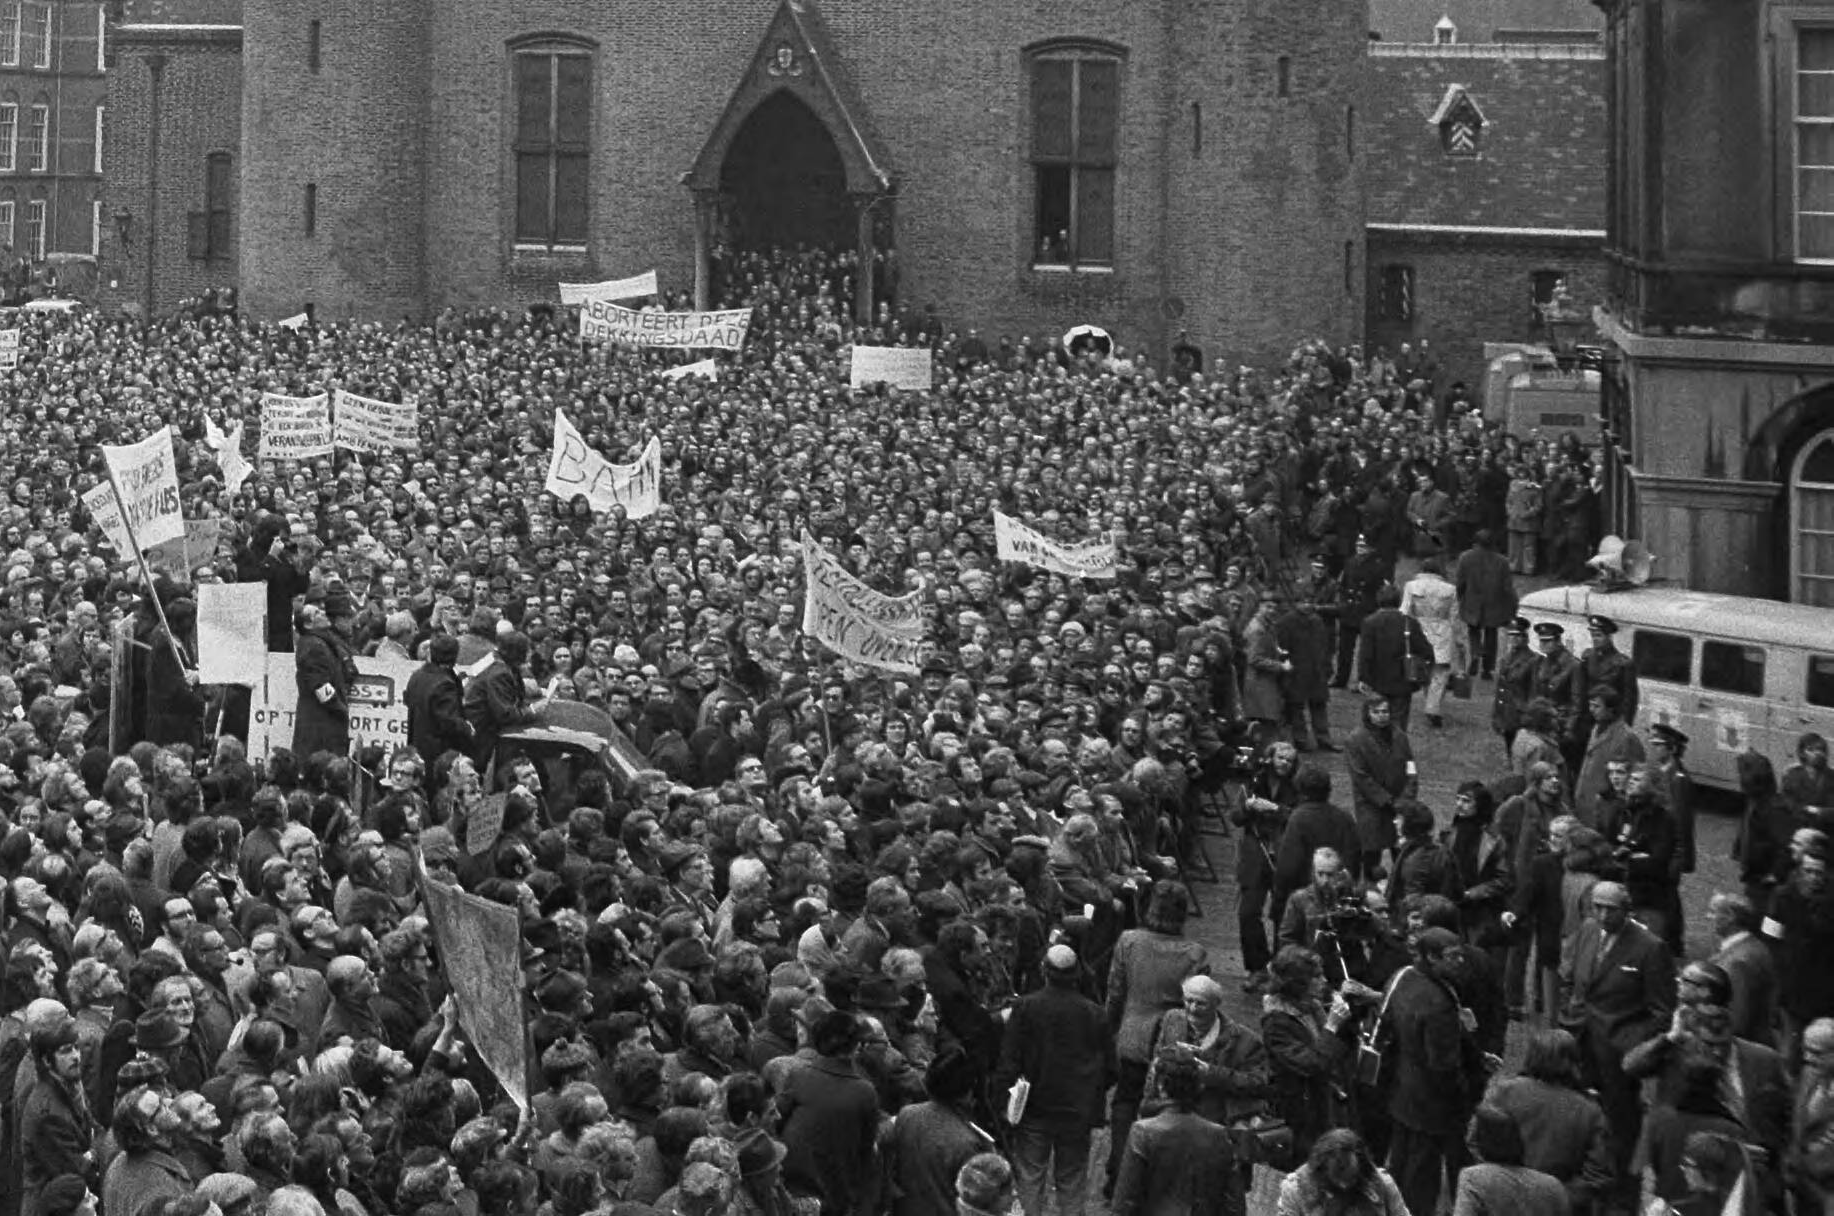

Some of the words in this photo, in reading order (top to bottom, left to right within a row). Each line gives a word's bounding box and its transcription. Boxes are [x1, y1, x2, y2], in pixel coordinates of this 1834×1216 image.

[581, 298, 688, 330] ABORTEERT
[700, 312, 752, 329] DEZE
[585, 320, 740, 346] DEKKINGSDAAD
